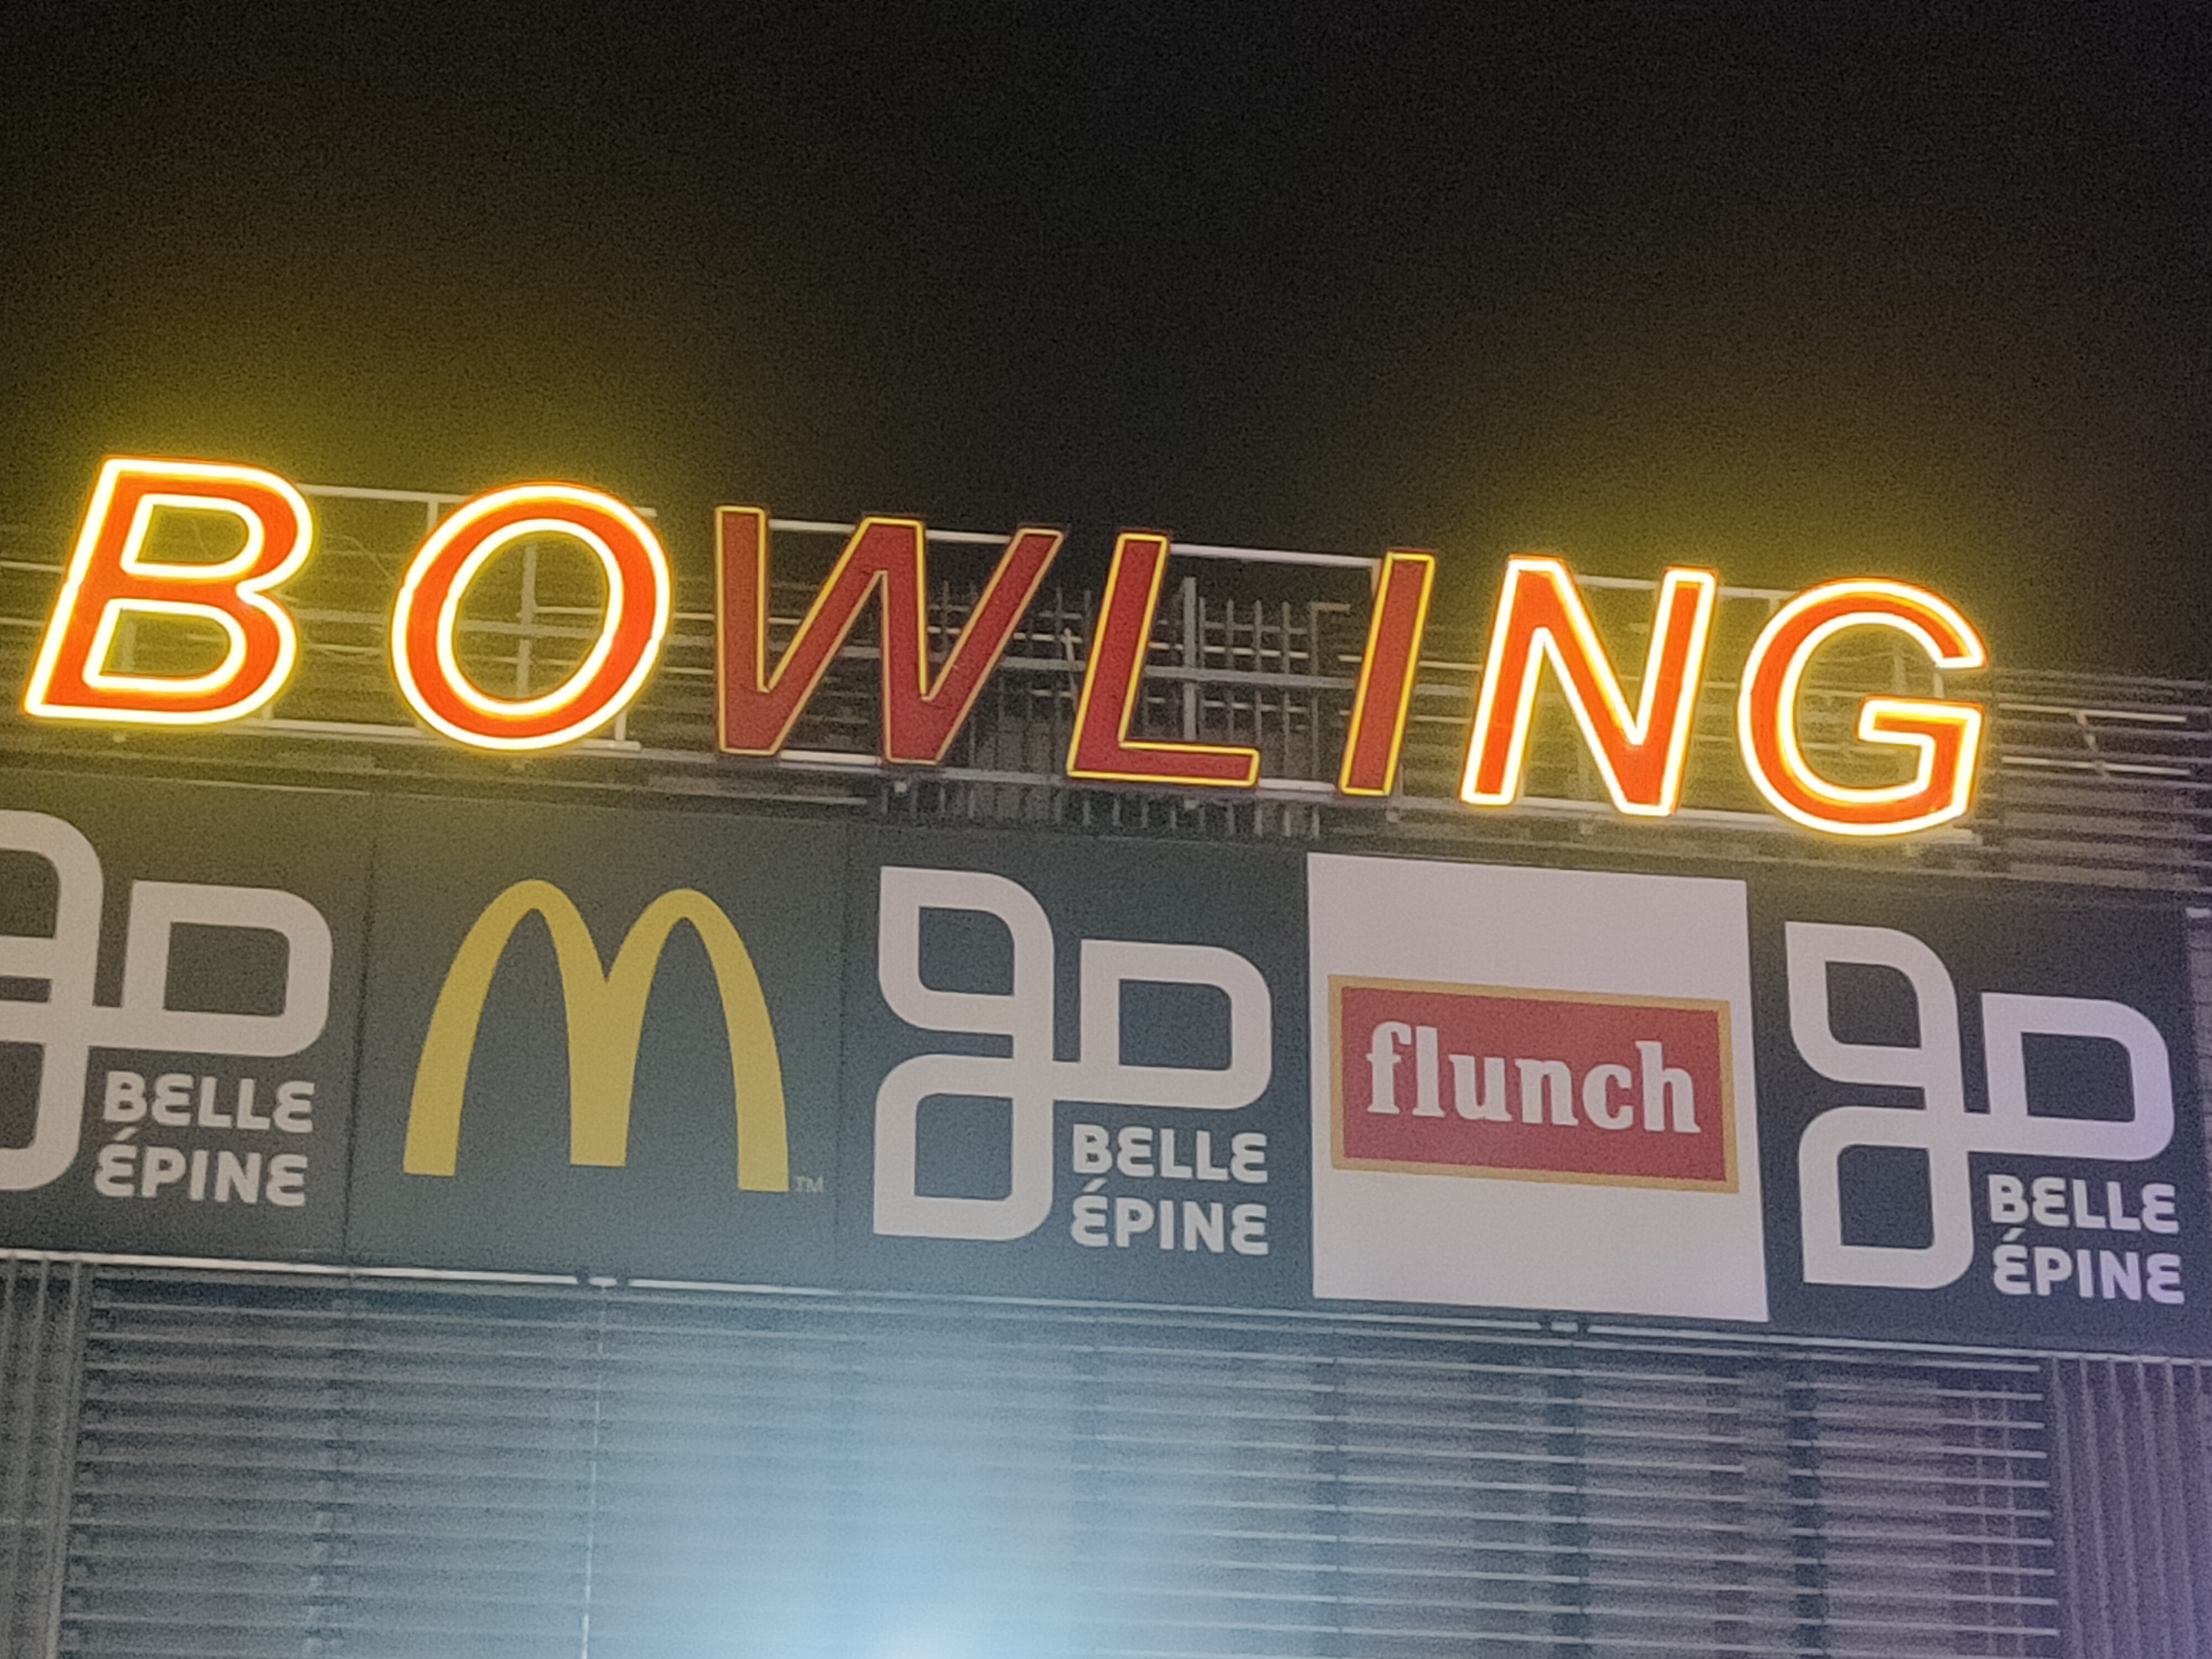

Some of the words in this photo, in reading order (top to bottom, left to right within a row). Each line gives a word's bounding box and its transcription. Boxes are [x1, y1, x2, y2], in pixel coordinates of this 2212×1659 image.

[23, 456, 1990, 838] BOWLING
[103, 1071, 315, 1133] BELLE
[1366, 1021, 1702, 1134] flunch
[95, 1127, 309, 1206] ÉPINE
[1072, 1124, 1268, 1183] BELLE
[1071, 1178, 1269, 1255] ÉPINE
[1988, 1173, 2179, 1234] BELLE
[1992, 1227, 2185, 1305] ÉPINE
